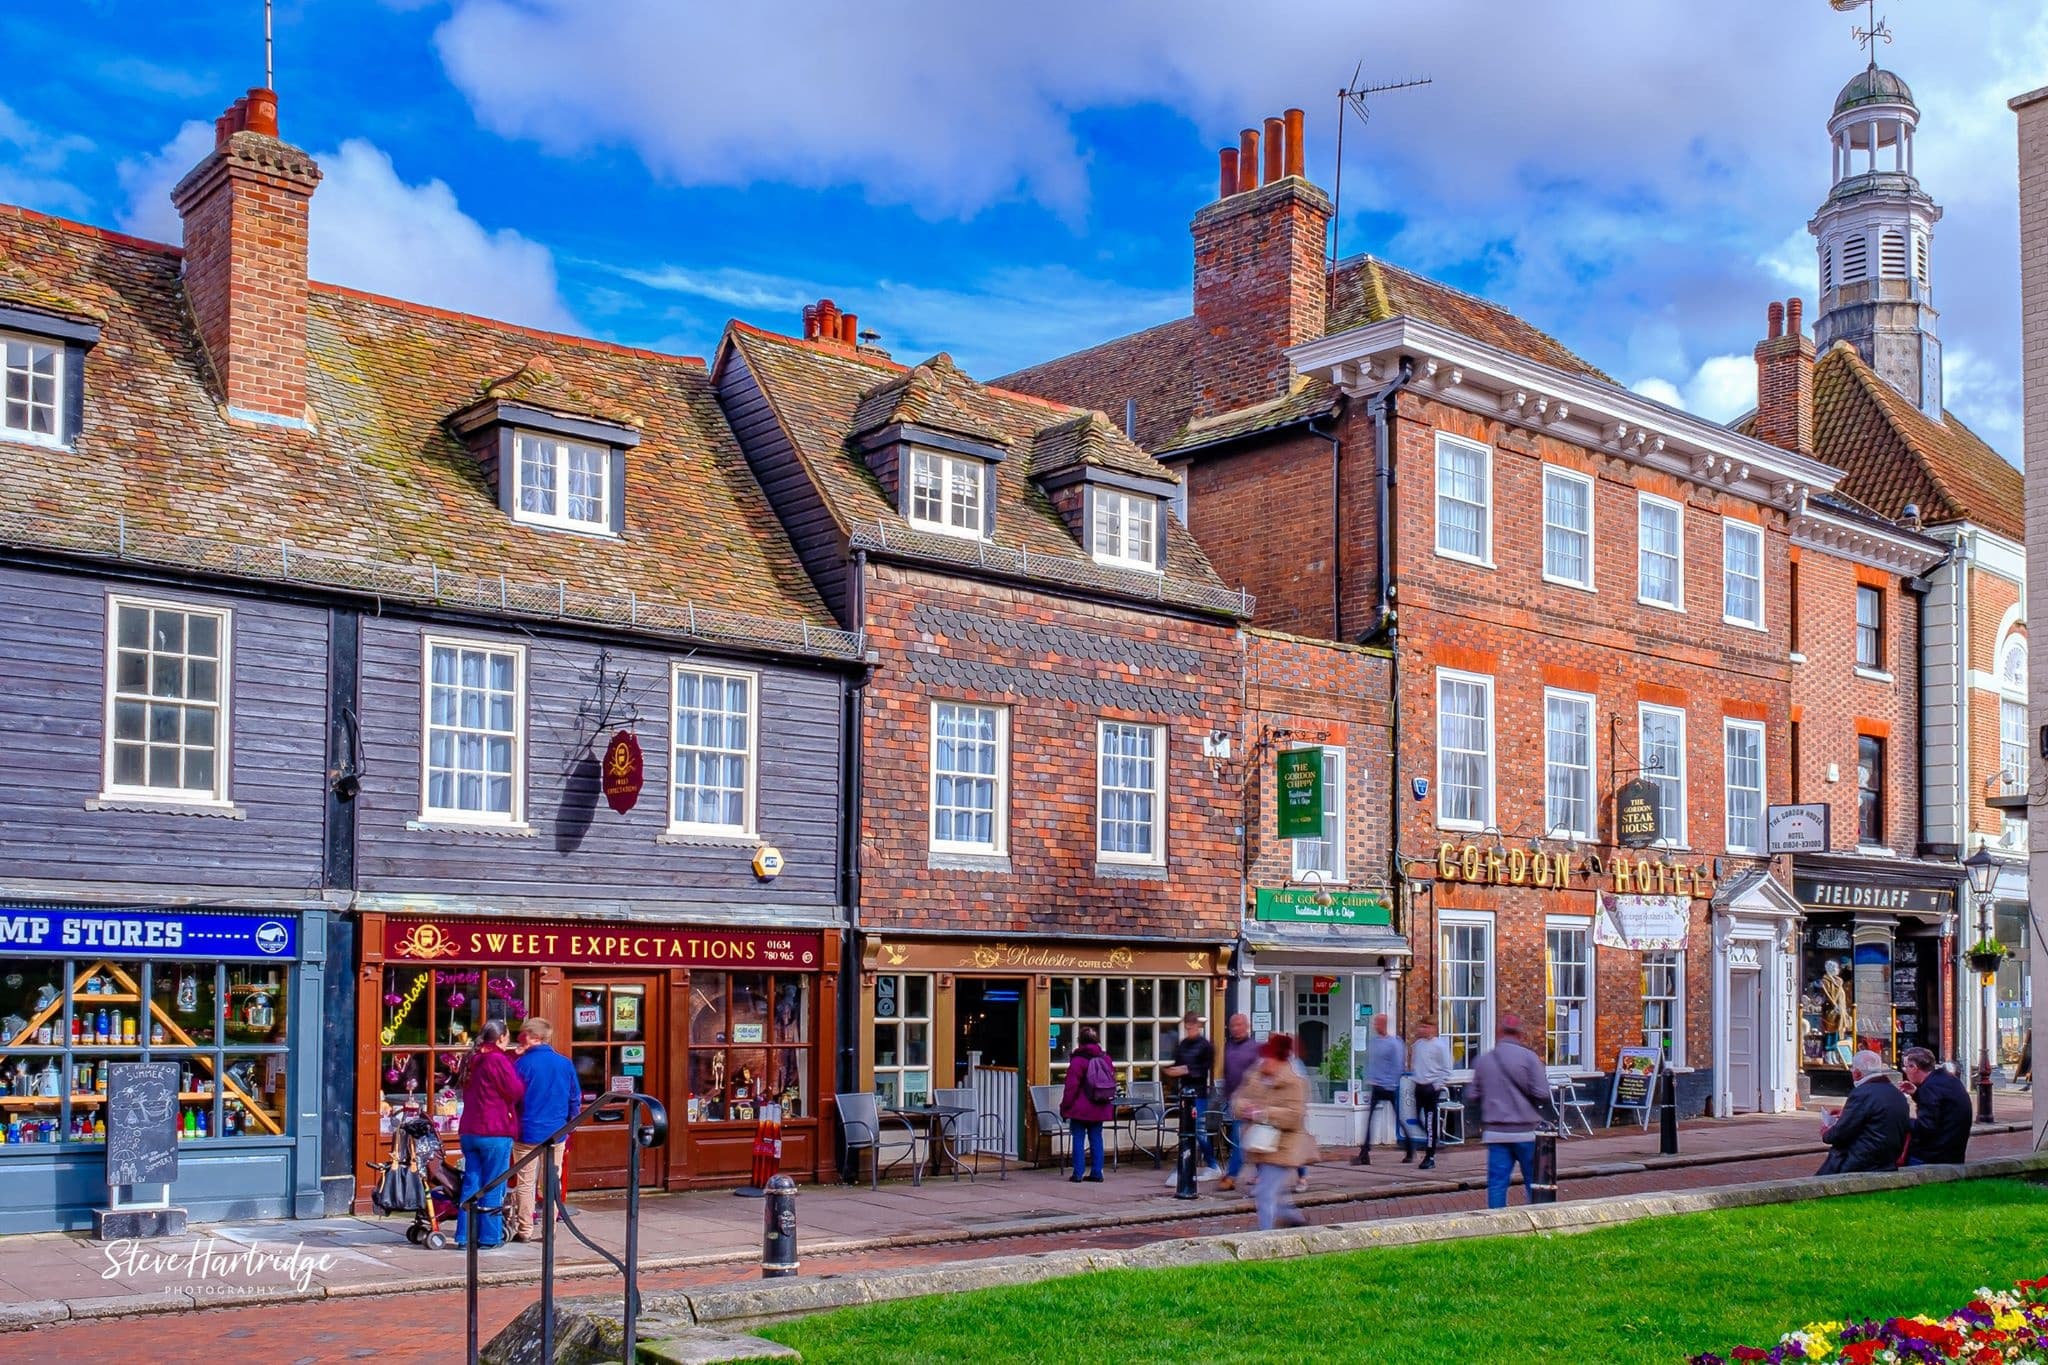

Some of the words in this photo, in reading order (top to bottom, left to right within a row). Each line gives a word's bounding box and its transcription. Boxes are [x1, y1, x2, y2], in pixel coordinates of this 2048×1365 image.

[1291, 763, 1309, 772] THE
[1284, 771, 1316, 781] GORDON
[1286, 779, 1313, 789] CHIPPY
[1630, 798, 1645, 806] THE
[1623, 804, 1651, 812] GORDON
[1622, 812, 1654, 823] STEAK
[1622, 822, 1656, 833] HOUSE
[1771, 841, 1780, 849] TEL
[1440, 842, 1570, 888] GORDON
[1615, 858, 1705, 896] HOTEL
[1273, 893, 1294, 904] THE
[1342, 896, 1375, 907] CHIPPY
[1815, 884, 1910, 908] FIELDSTAFF
[62, 919, 183, 947] STORES
[470, 933, 559, 953] SWEET
[571, 935, 756, 960] EXPECTATIONS
[766, 940, 791, 950] 01634
[763, 950, 778, 961] 780
[779, 951, 794, 961] 965
[1007, 945, 1076, 967] Rochester
[1077, 960, 1101, 968] COFFEE
[1785, 961, 1793, 1042] HOTEL
[380, 971, 428, 1046] Chocolate
[126, 1070, 165, 1081] SUMMER
[161, 1066, 176, 1077] FOR
